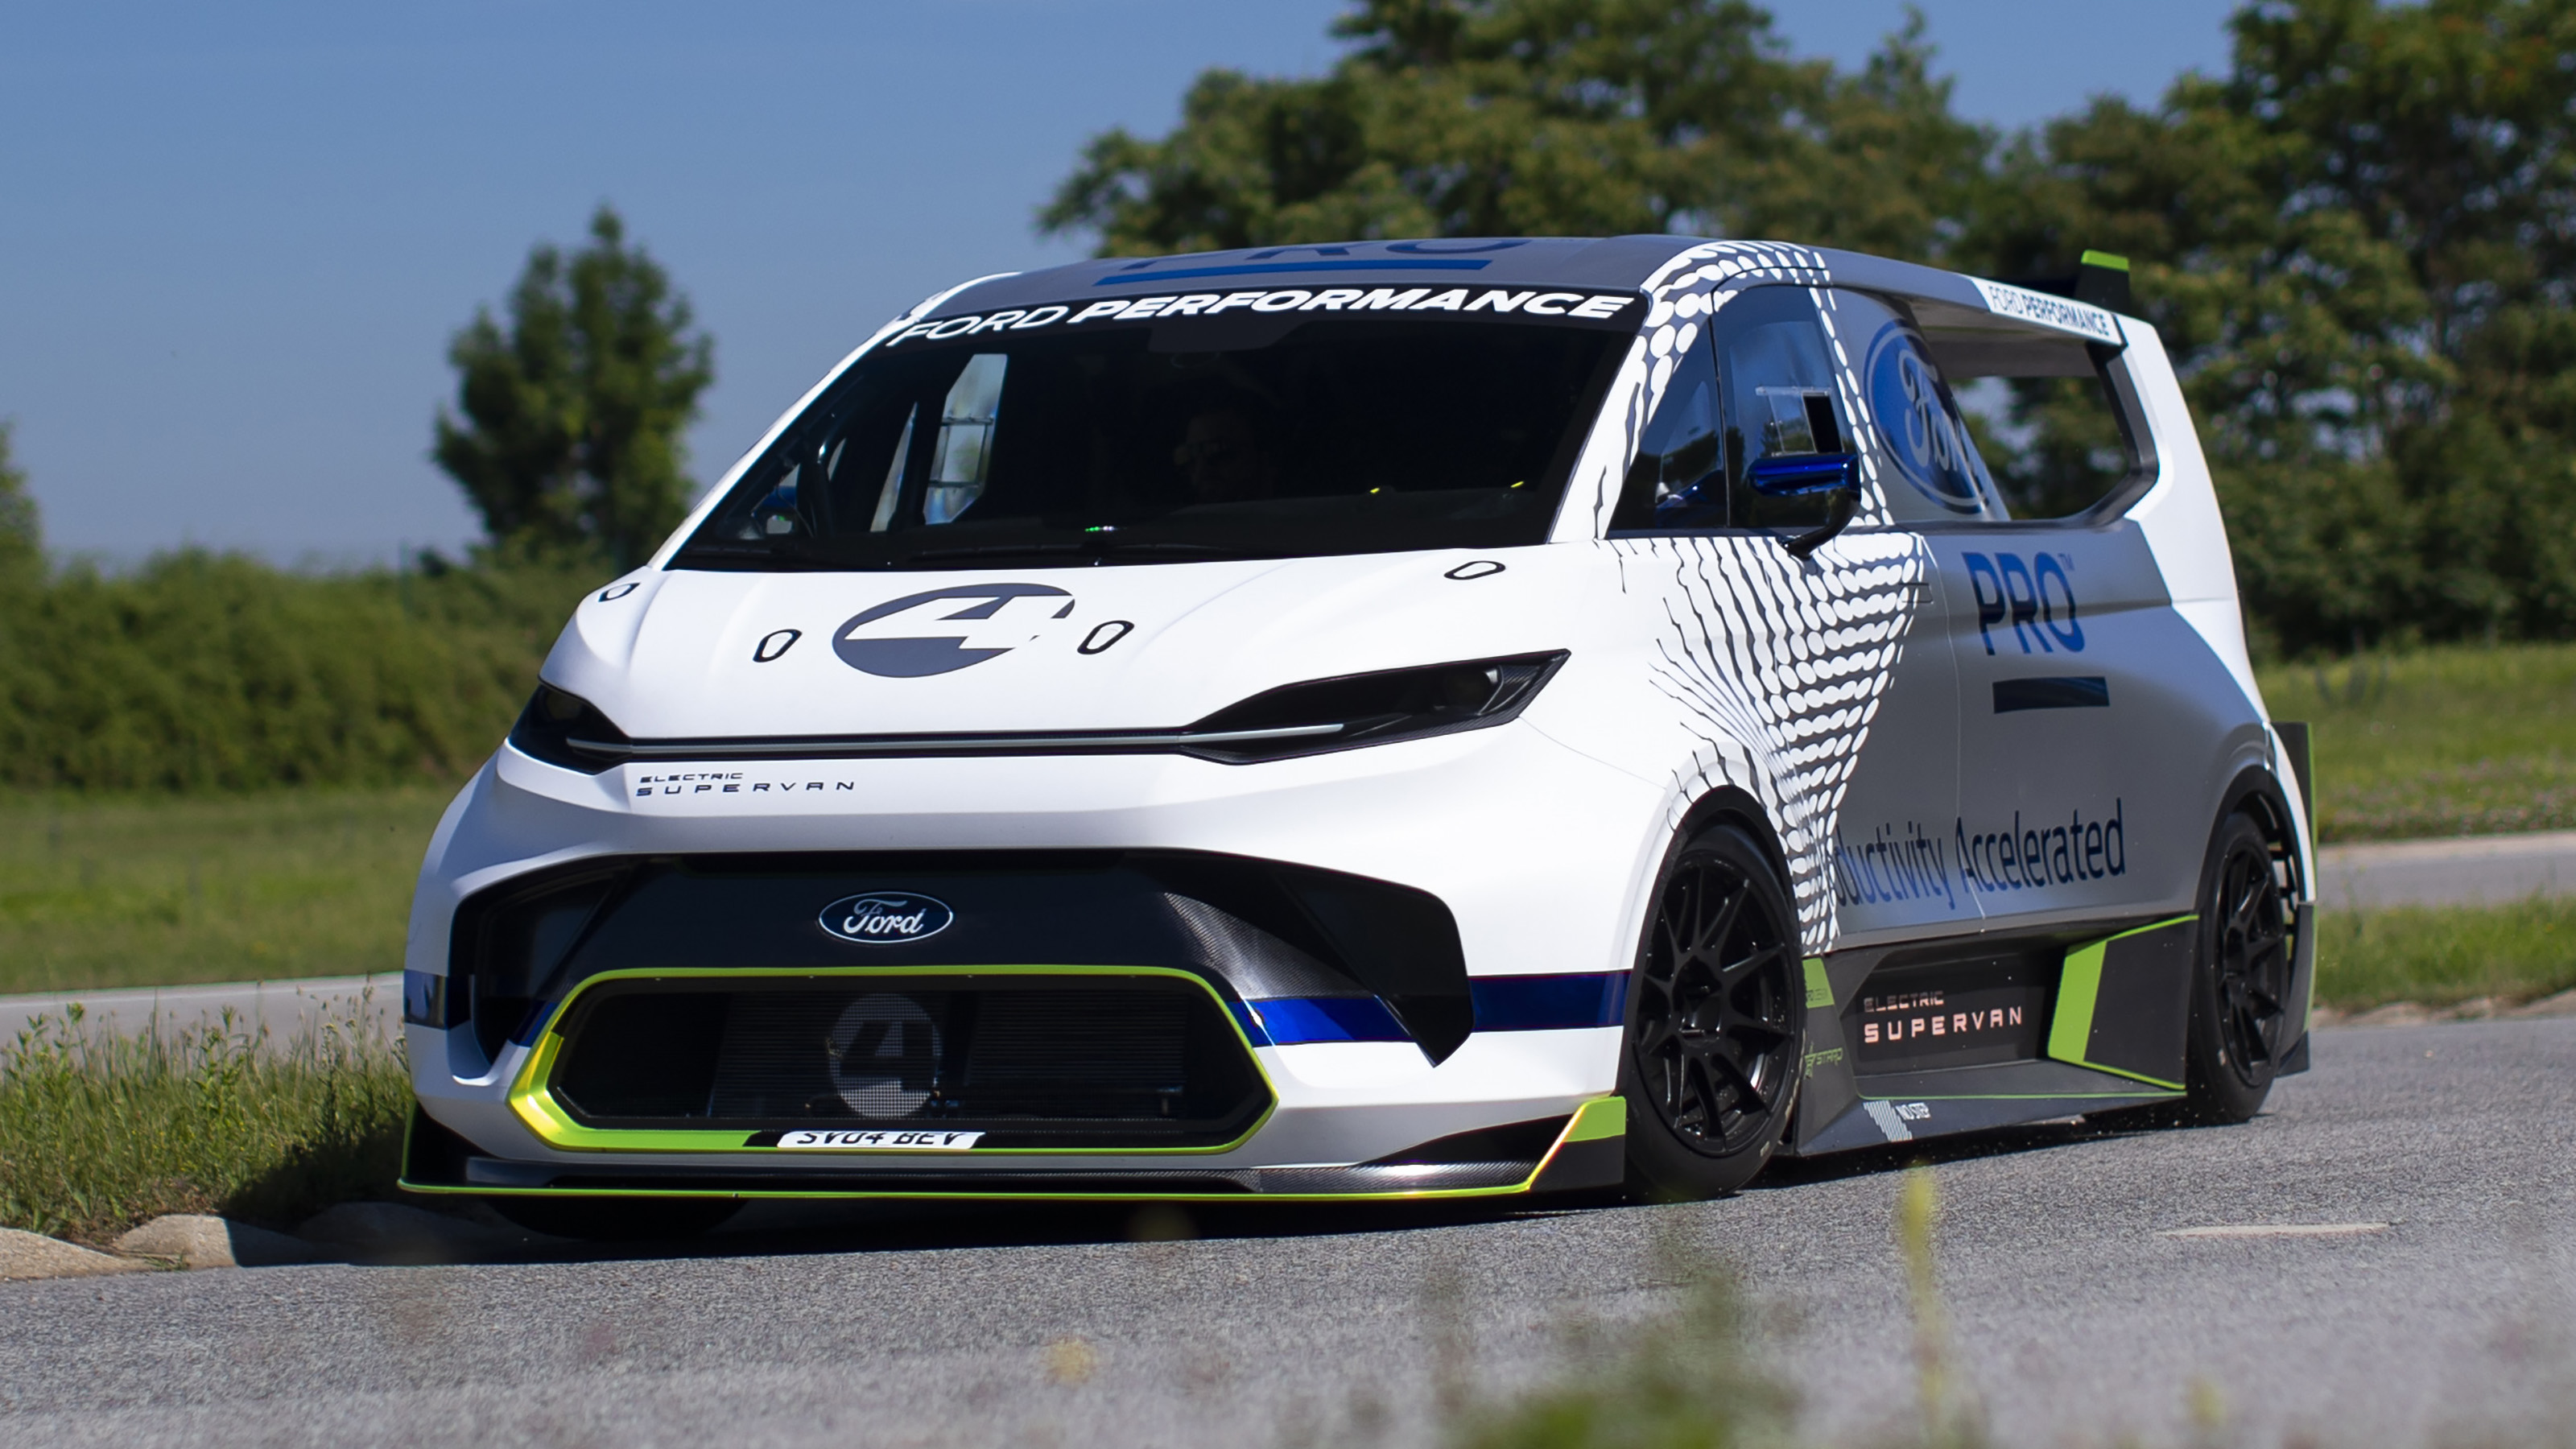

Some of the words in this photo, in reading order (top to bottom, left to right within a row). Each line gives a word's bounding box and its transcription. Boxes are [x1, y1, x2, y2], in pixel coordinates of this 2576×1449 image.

[886, 305, 1067, 347] FORD
[1067, 287, 1633, 324] PERFORMANCE
[1988, 285, 2023, 315] FORD
[2021, 294, 2110, 336] PERFORMANCE
[636, 781, 855, 797] SUPERVAN
[639, 772, 744, 784] ELECTRIC
[1955, 797, 2127, 895] Accelerated
[842, 898, 925, 935] Ford
[1863, 991, 1945, 1012] ELECTRIC
[1864, 1006, 2022, 1044] SUPERVAN
